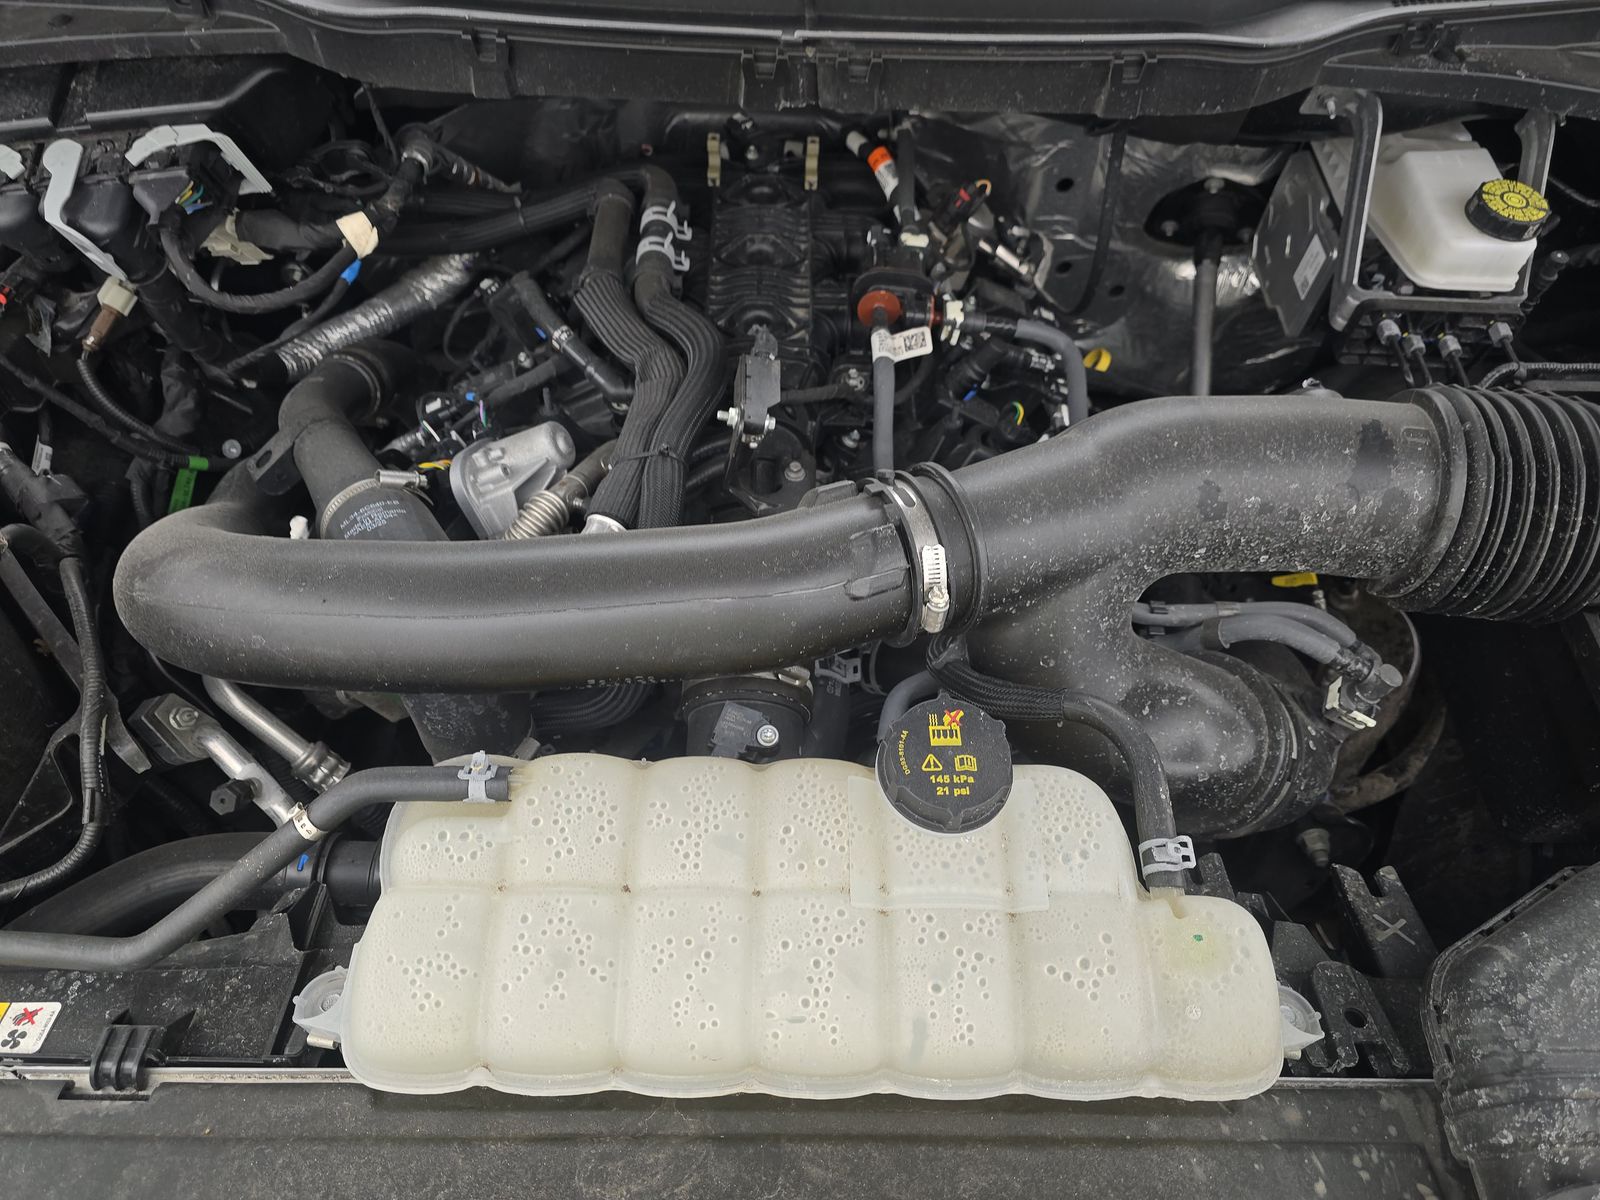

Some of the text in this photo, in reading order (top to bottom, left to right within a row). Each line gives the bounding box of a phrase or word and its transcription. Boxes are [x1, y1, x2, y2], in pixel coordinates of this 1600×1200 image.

[929, 774, 975, 784] 145 kPa
[936, 786, 970, 797] 21 psi
